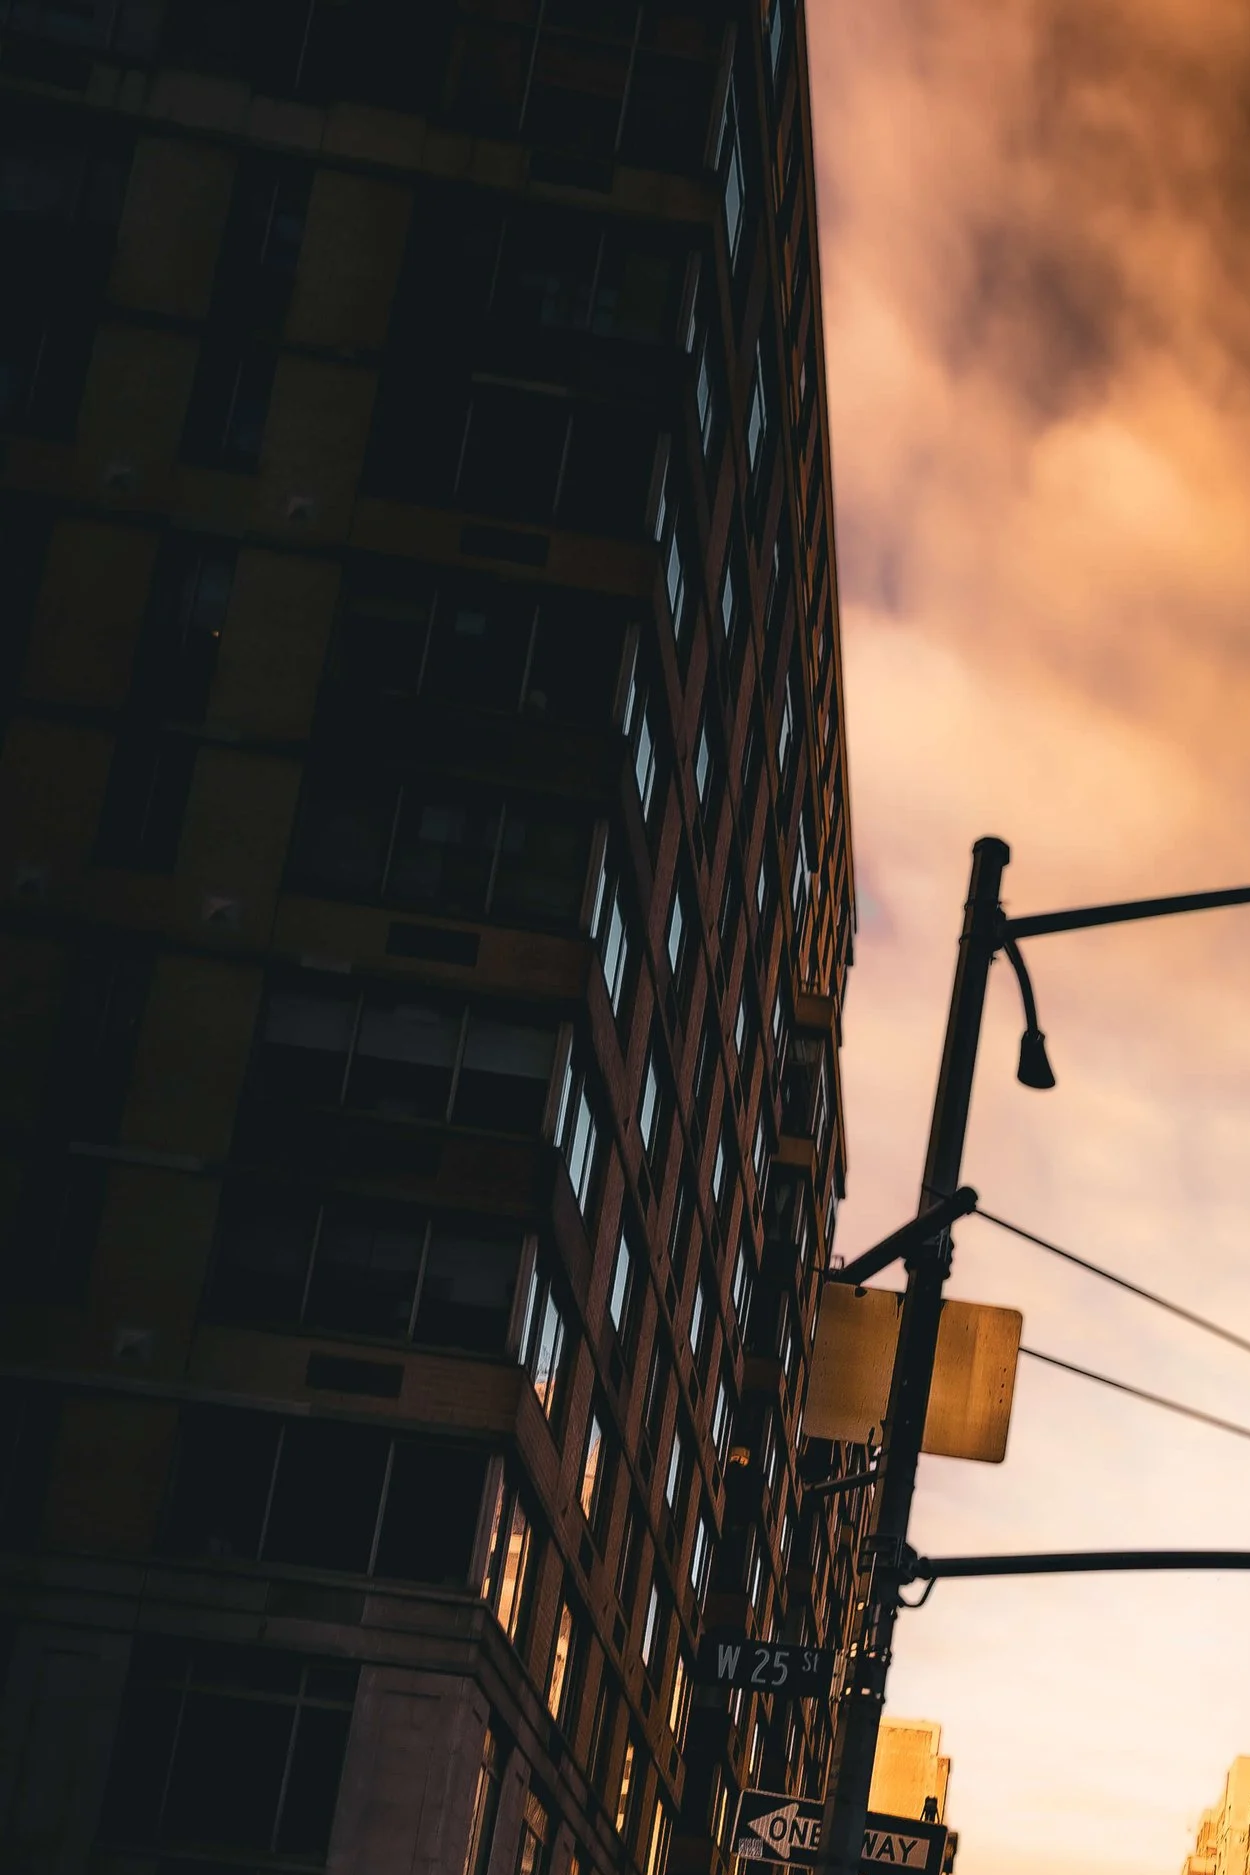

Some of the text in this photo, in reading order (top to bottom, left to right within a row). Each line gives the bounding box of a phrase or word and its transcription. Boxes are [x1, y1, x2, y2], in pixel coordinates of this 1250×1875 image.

[717, 1643, 820, 1686] W 25 St
[769, 1815, 823, 1848] ONE
[861, 1830, 918, 1865] WAY
